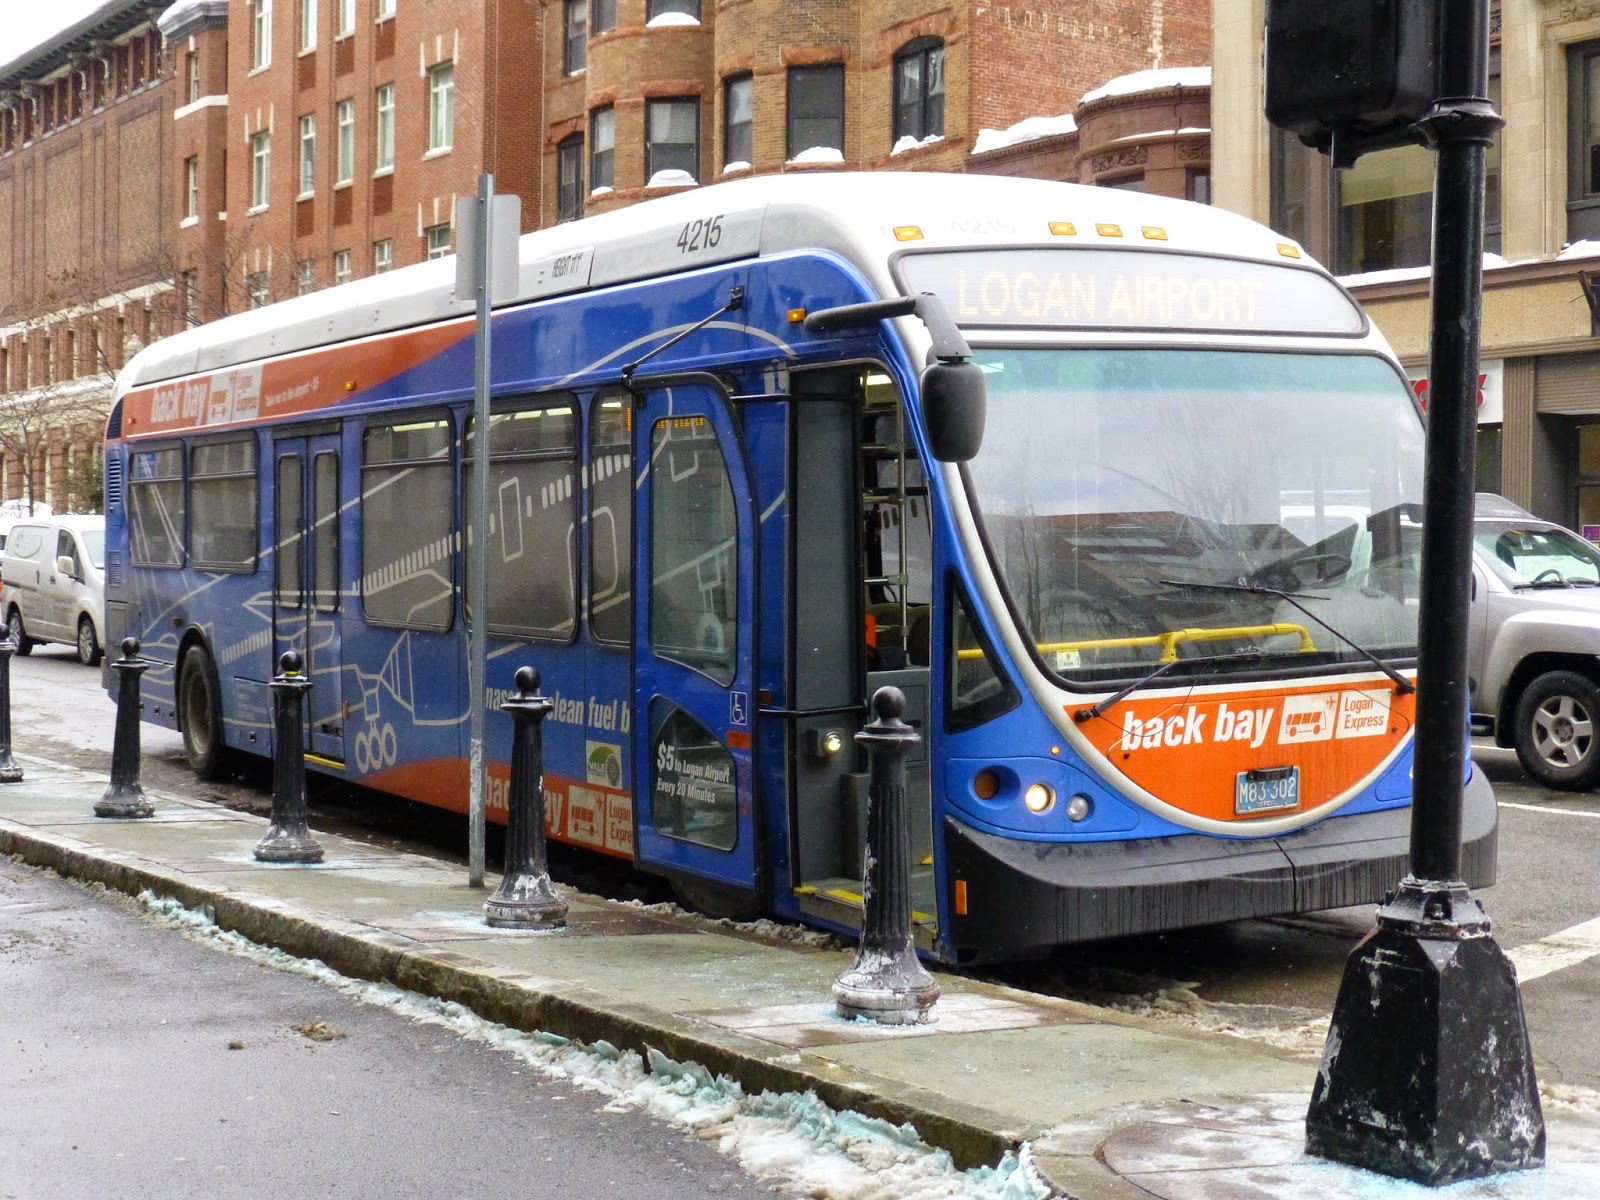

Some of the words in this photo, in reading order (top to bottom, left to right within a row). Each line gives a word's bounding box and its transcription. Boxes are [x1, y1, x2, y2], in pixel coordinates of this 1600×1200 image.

[677, 214, 724, 254] 4215
[956, 270, 1096, 320] LOGAN
[1107, 274, 1264, 323] AIRPORT
[150, 382, 182, 423] back
[182, 379, 208, 426] bay
[588, 696, 617, 731] fuel
[1344, 697, 1374, 714] Logan
[1344, 713, 1384, 731] Express
[1121, 710, 1206, 751] back
[1213, 703, 1275, 749] bay
[656, 740, 675, 772] $5
[675, 759, 681, 771] to
[683, 760, 704, 778] Logan
[704, 765, 730, 783] Airport
[484, 765, 511, 812] bac
[543, 789, 563, 835] ay
[657, 777, 676, 797] Every
[677, 782, 686, 796] 20
[687, 784, 716, 804] Minutes
[609, 799, 631, 824] Logan
[611, 822, 632, 844] Expre
